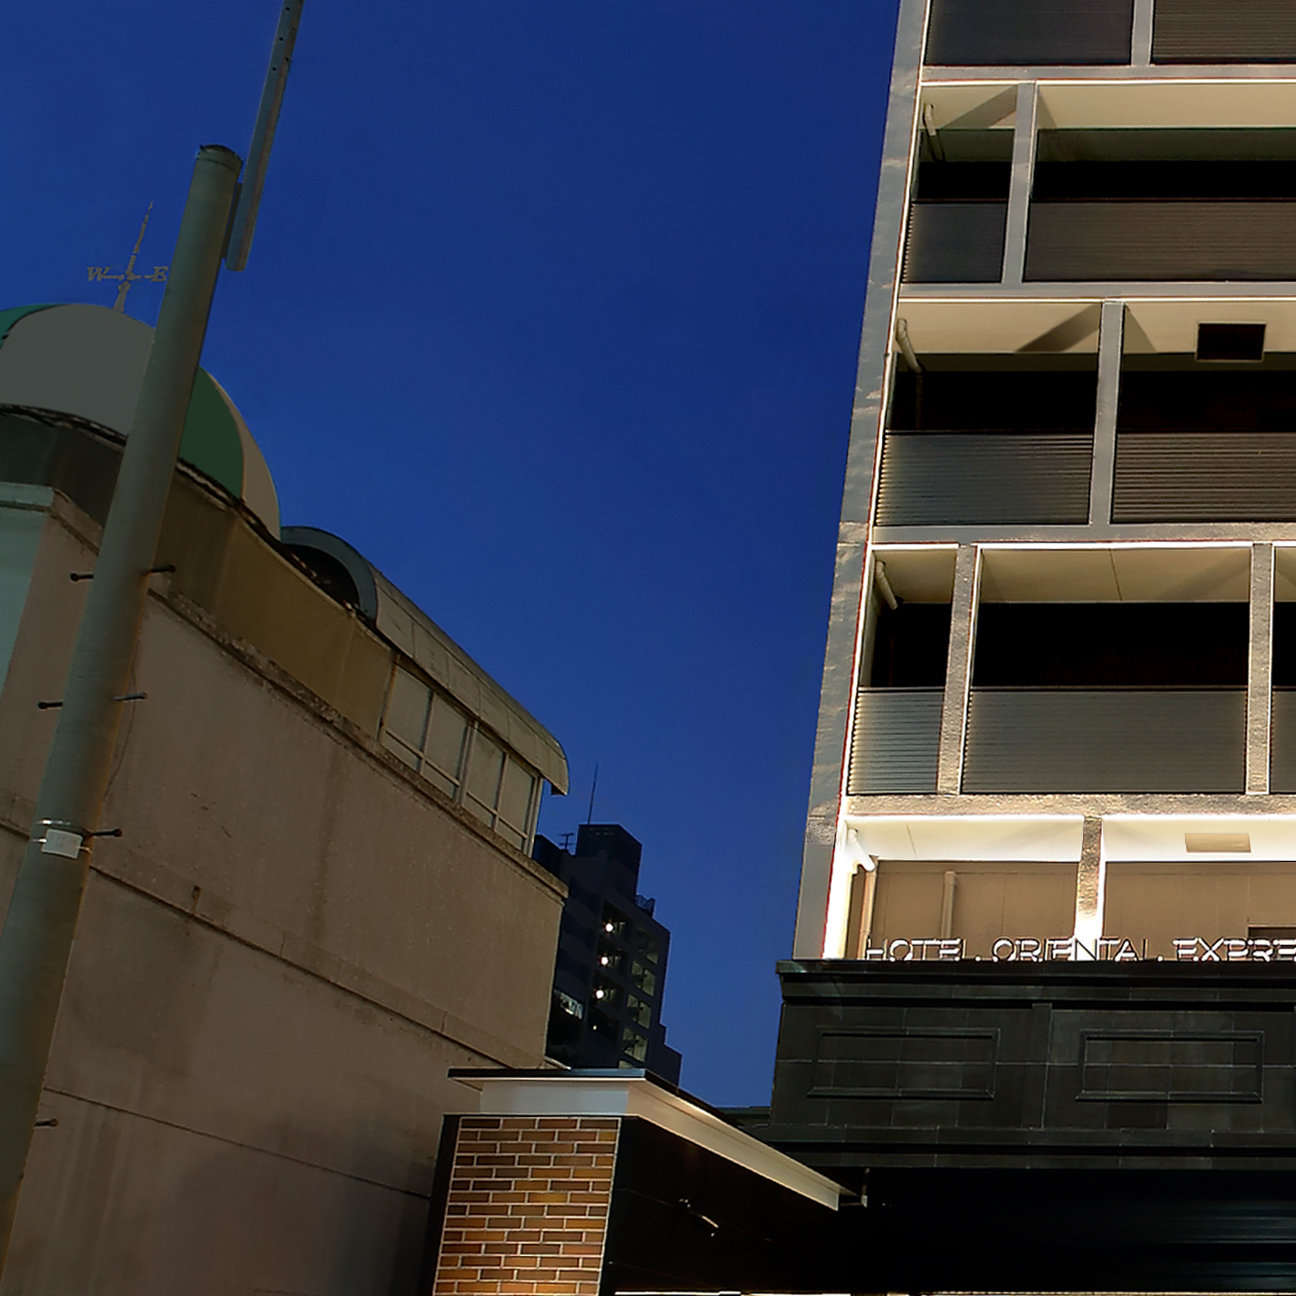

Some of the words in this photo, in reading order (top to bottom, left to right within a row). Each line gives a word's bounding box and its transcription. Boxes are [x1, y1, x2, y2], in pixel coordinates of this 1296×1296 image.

[88, 266, 110, 282] W
[150, 265, 169, 282] E
[865, 937, 981, 962] HOTEL
[991, 937, 1163, 962] ORIENTAL
